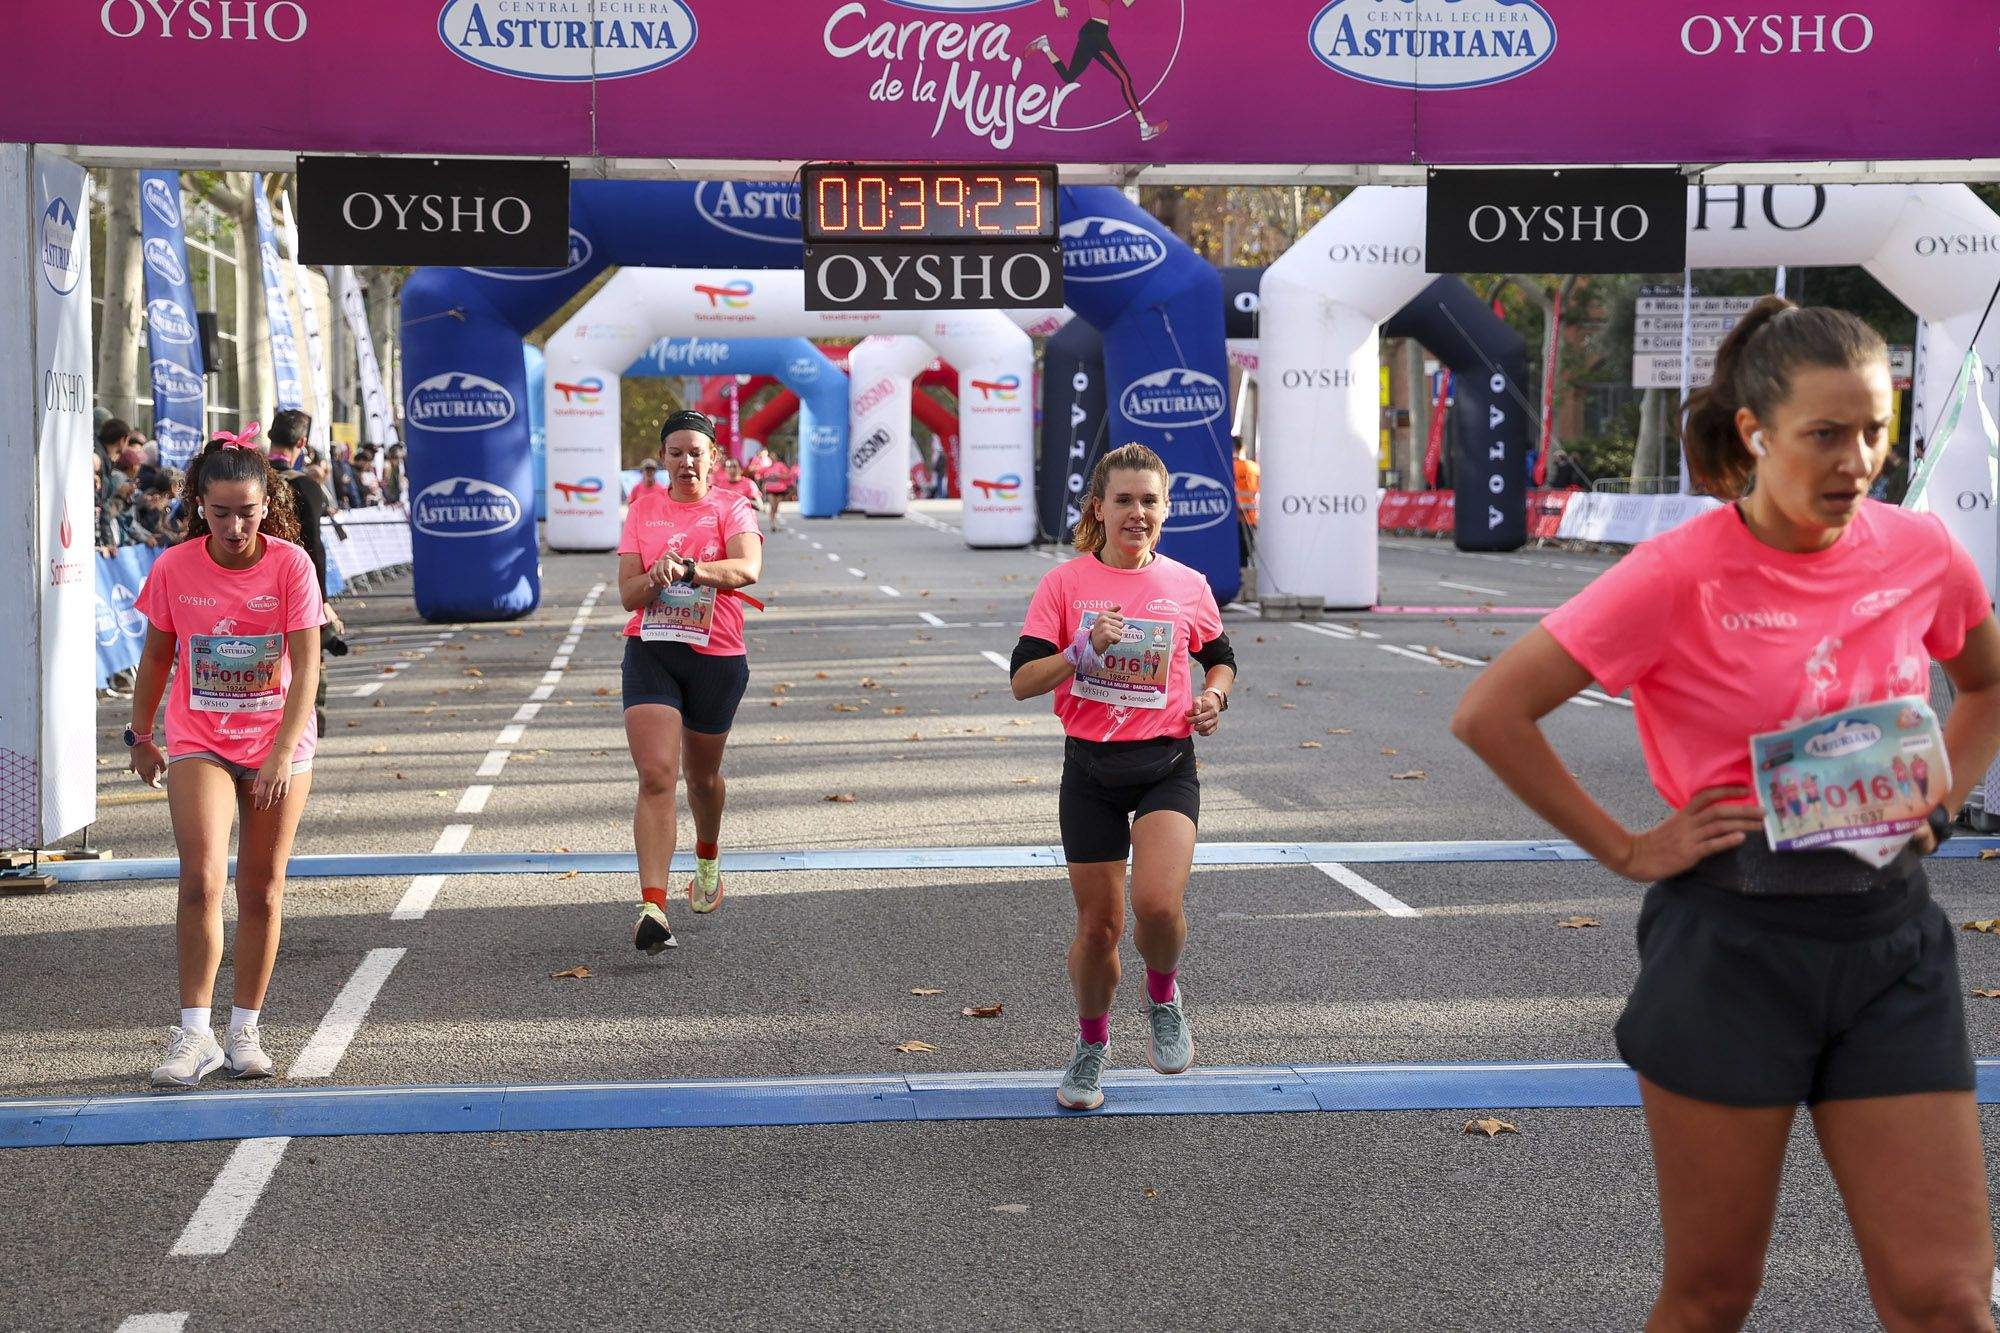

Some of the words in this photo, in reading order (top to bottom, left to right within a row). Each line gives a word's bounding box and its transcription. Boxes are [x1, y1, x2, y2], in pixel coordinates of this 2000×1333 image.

[499, 1, 580, 13] CENTRAL
[588, 0, 669, 14] LECHERA
[1367, 10, 1443, 22] CENTRAL
[1451, 11, 1530, 22] LECHERA
[101, 0, 308, 42] OYSHO
[459, 3, 678, 49] ASTURIANA
[823, 3, 1011, 62] Carrera
[1328, 14, 1537, 58] ASTURIANA
[1680, 13, 1875, 56] OYSHO
[868, 63, 904, 102] de
[912, 62, 937, 103] la
[931, 57, 1082, 149] Mujer
[342, 191, 532, 235] OYSHO
[817, 177, 1041, 231] 00:39:23
[1468, 204, 1650, 243] OYSHO
[1329, 244, 1421, 265] OYSHO
[816, 253, 1051, 303] OYSHO
[44, 370, 85, 414] OYSHO
[1128, 392, 1222, 415] ASTURIANA
[412, 397, 508, 420] ASTURIANA
[1066, 371, 1089, 529] VOLVO
[1489, 373, 1506, 530] VOLVO
[418, 500, 514, 524] ASTURIANA
[1281, 495, 1367, 515] OYSHO
[178, 594, 217, 607] OYSHO
[664, 606, 691, 618] 016
[1073, 600, 1114, 610] OYSHO
[1720, 611, 1798, 631] OYSHO
[219, 646, 255, 655] ASTURIANA
[1105, 654, 1141, 673] 016
[219, 669, 255, 683] 016
[1109, 673, 1131, 682] 19847
[1113, 682, 1130, 690] MUJER
[200, 698, 229, 708] OYSHO
[1082, 686, 1110, 698] OYSHO
[1127, 695, 1157, 703] Santander
[1824, 775, 1894, 808] 016
